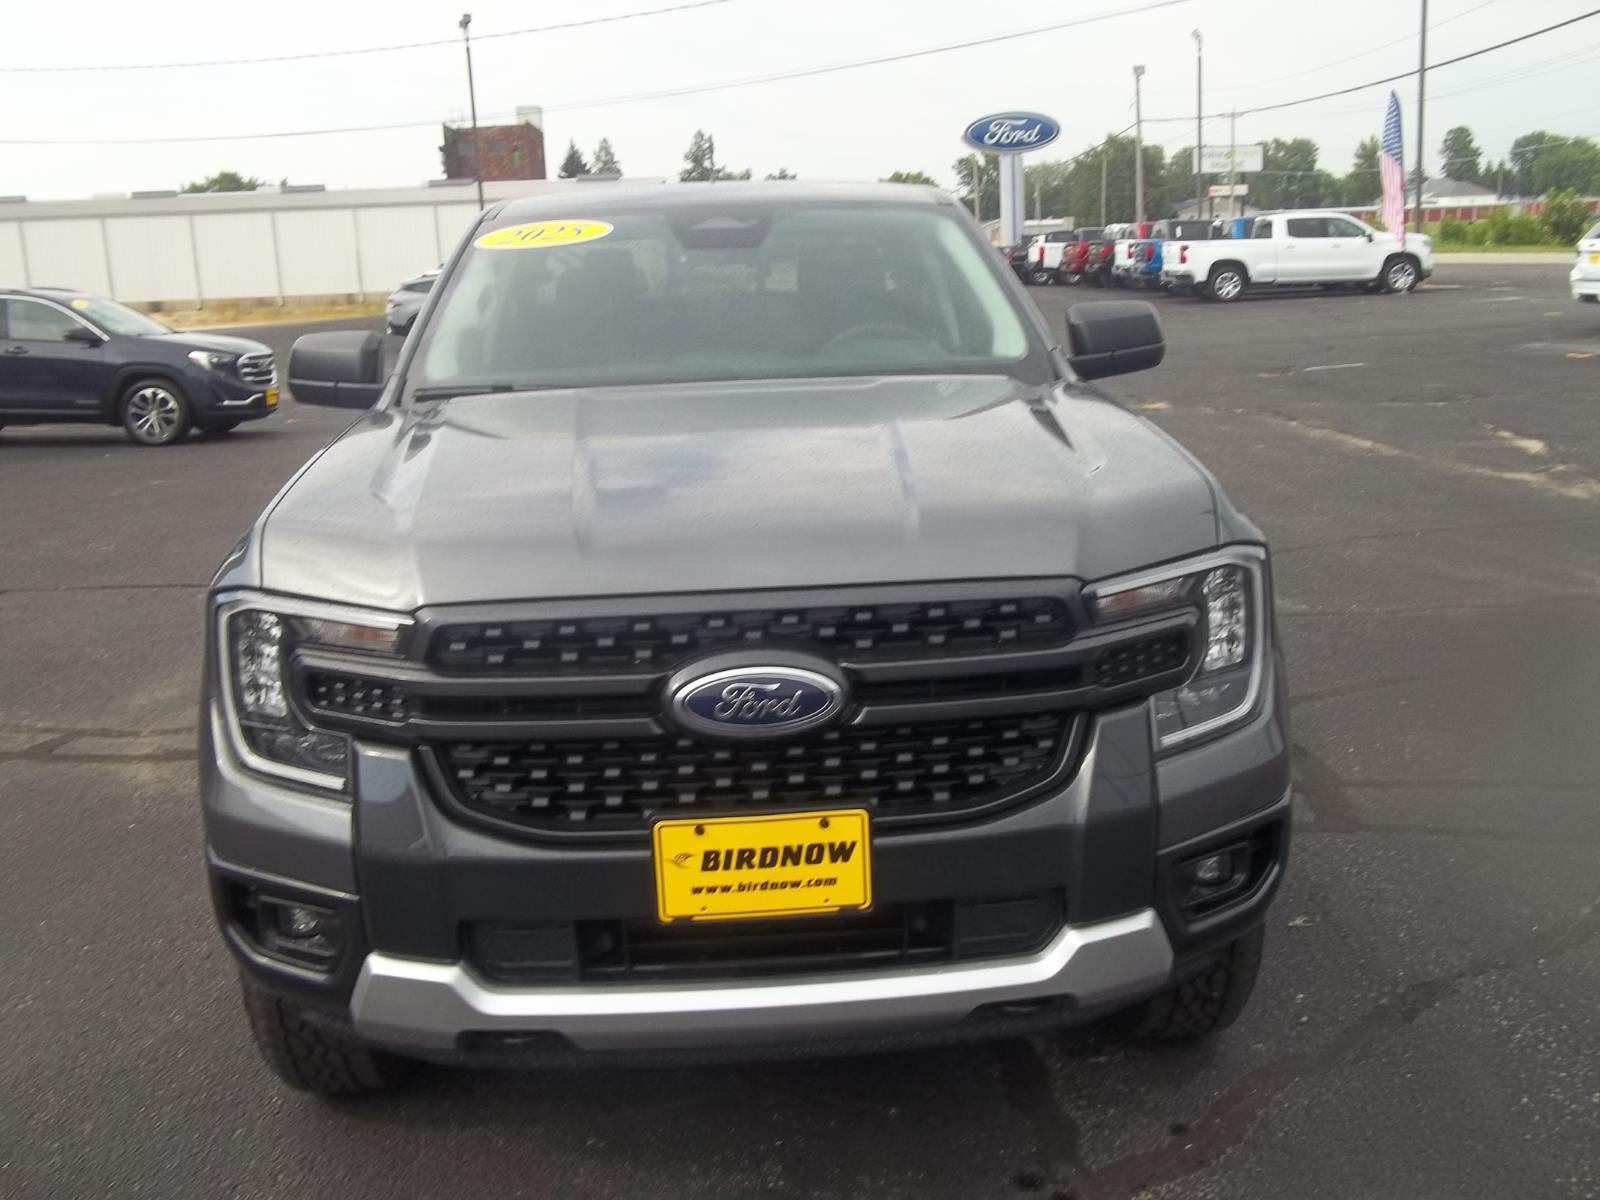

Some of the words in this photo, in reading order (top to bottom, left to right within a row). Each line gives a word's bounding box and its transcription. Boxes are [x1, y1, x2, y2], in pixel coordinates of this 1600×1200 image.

[983, 118, 1042, 145] Ford
[498, 223, 589, 245] 2025
[714, 682, 803, 720] Ford
[701, 841, 857, 872] BIRDNOW
[691, 877, 838, 896] www.birdnow.com
